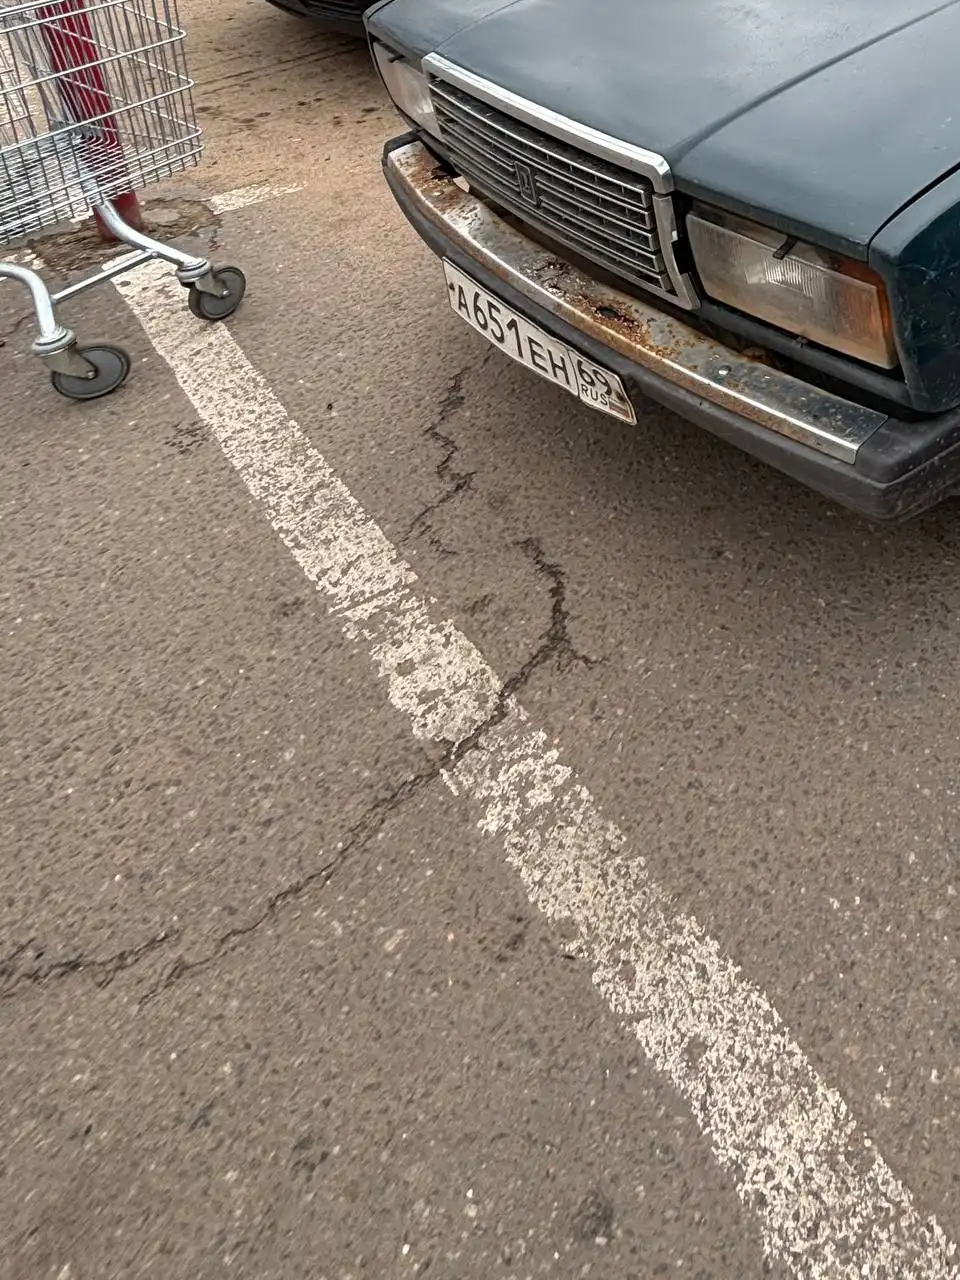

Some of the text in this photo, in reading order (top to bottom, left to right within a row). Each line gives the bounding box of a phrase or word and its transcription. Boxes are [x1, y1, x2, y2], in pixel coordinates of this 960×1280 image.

[457, 284, 612, 396] А651ЕН 69
[580, 383, 609, 407] RUS
